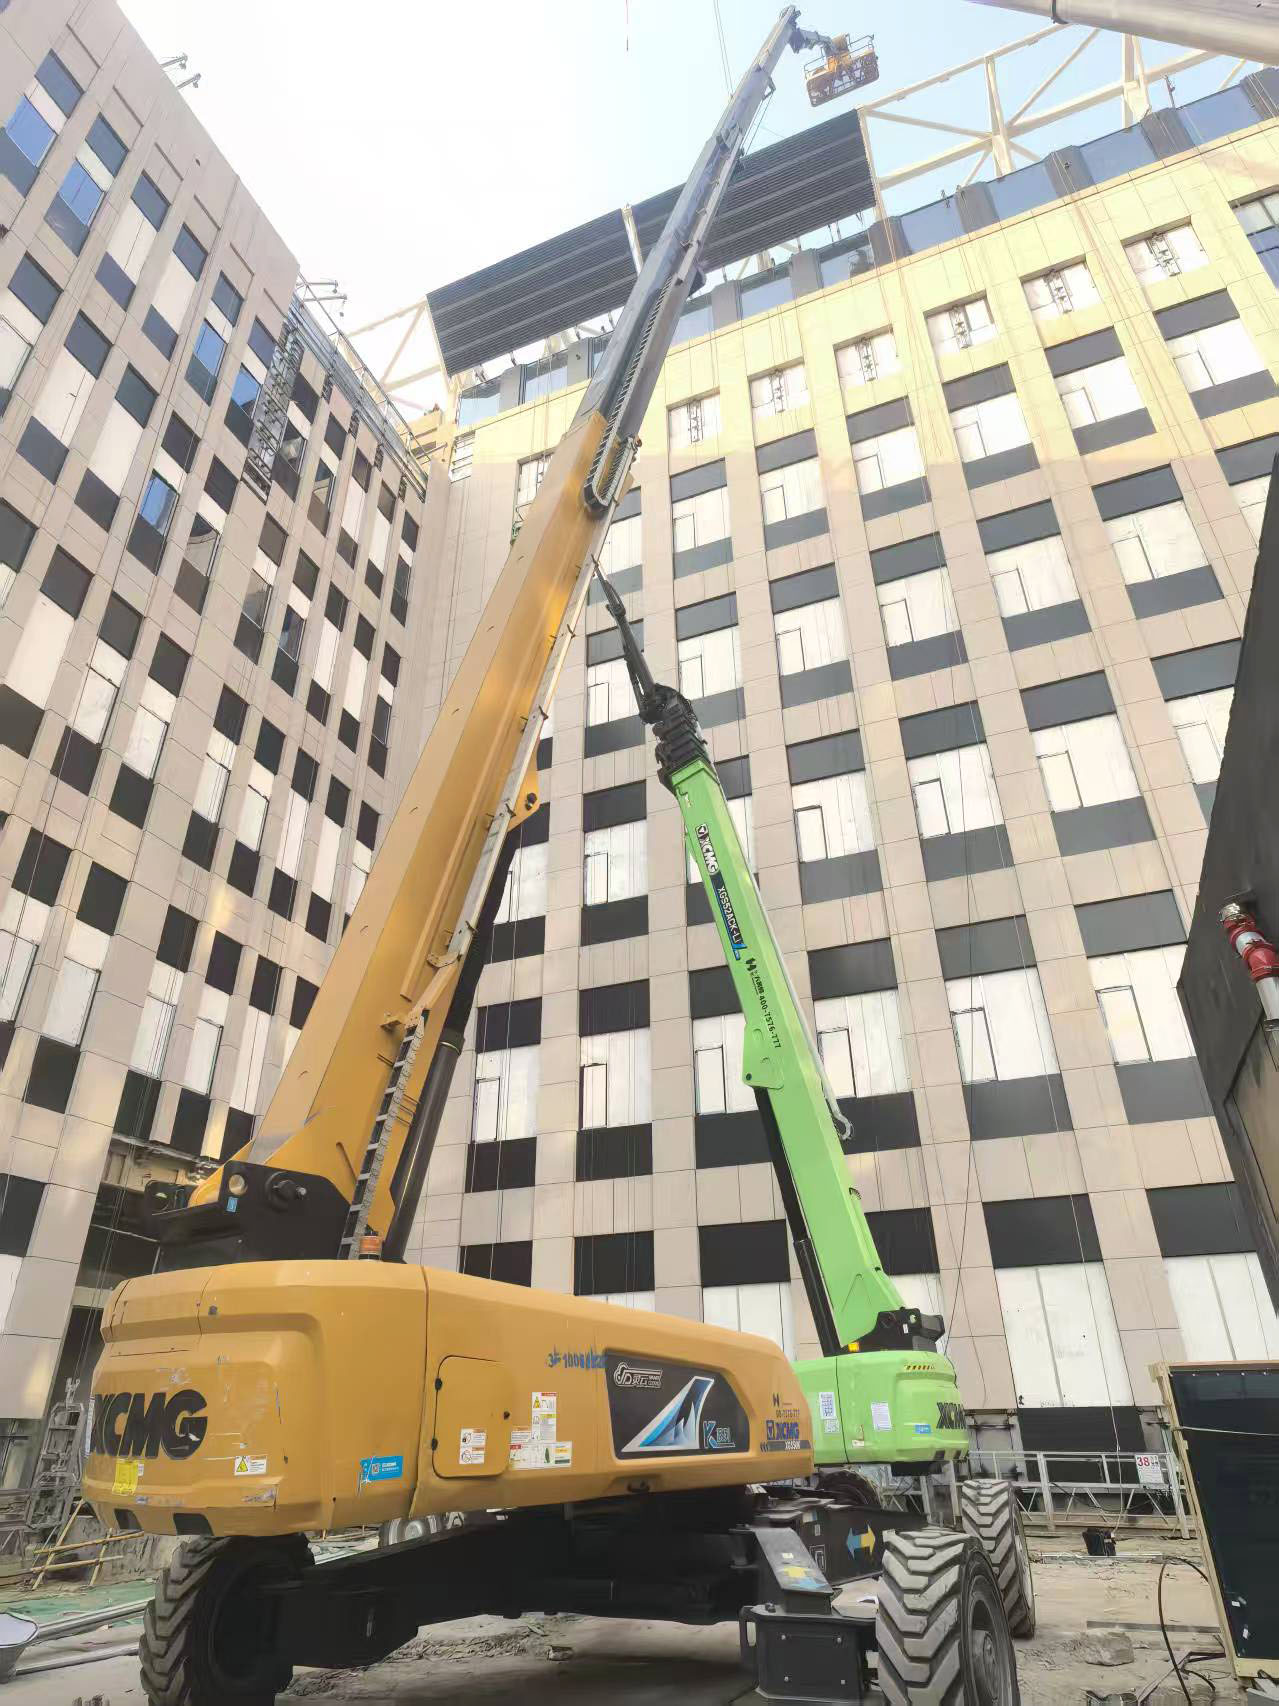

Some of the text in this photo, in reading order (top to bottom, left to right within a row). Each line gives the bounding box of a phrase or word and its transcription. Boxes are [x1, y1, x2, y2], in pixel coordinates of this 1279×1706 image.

[699, 833, 719, 875] XCMG
[759, 994, 782, 1049] 400-7576-777
[1137, 1456, 1150, 1467] 38
